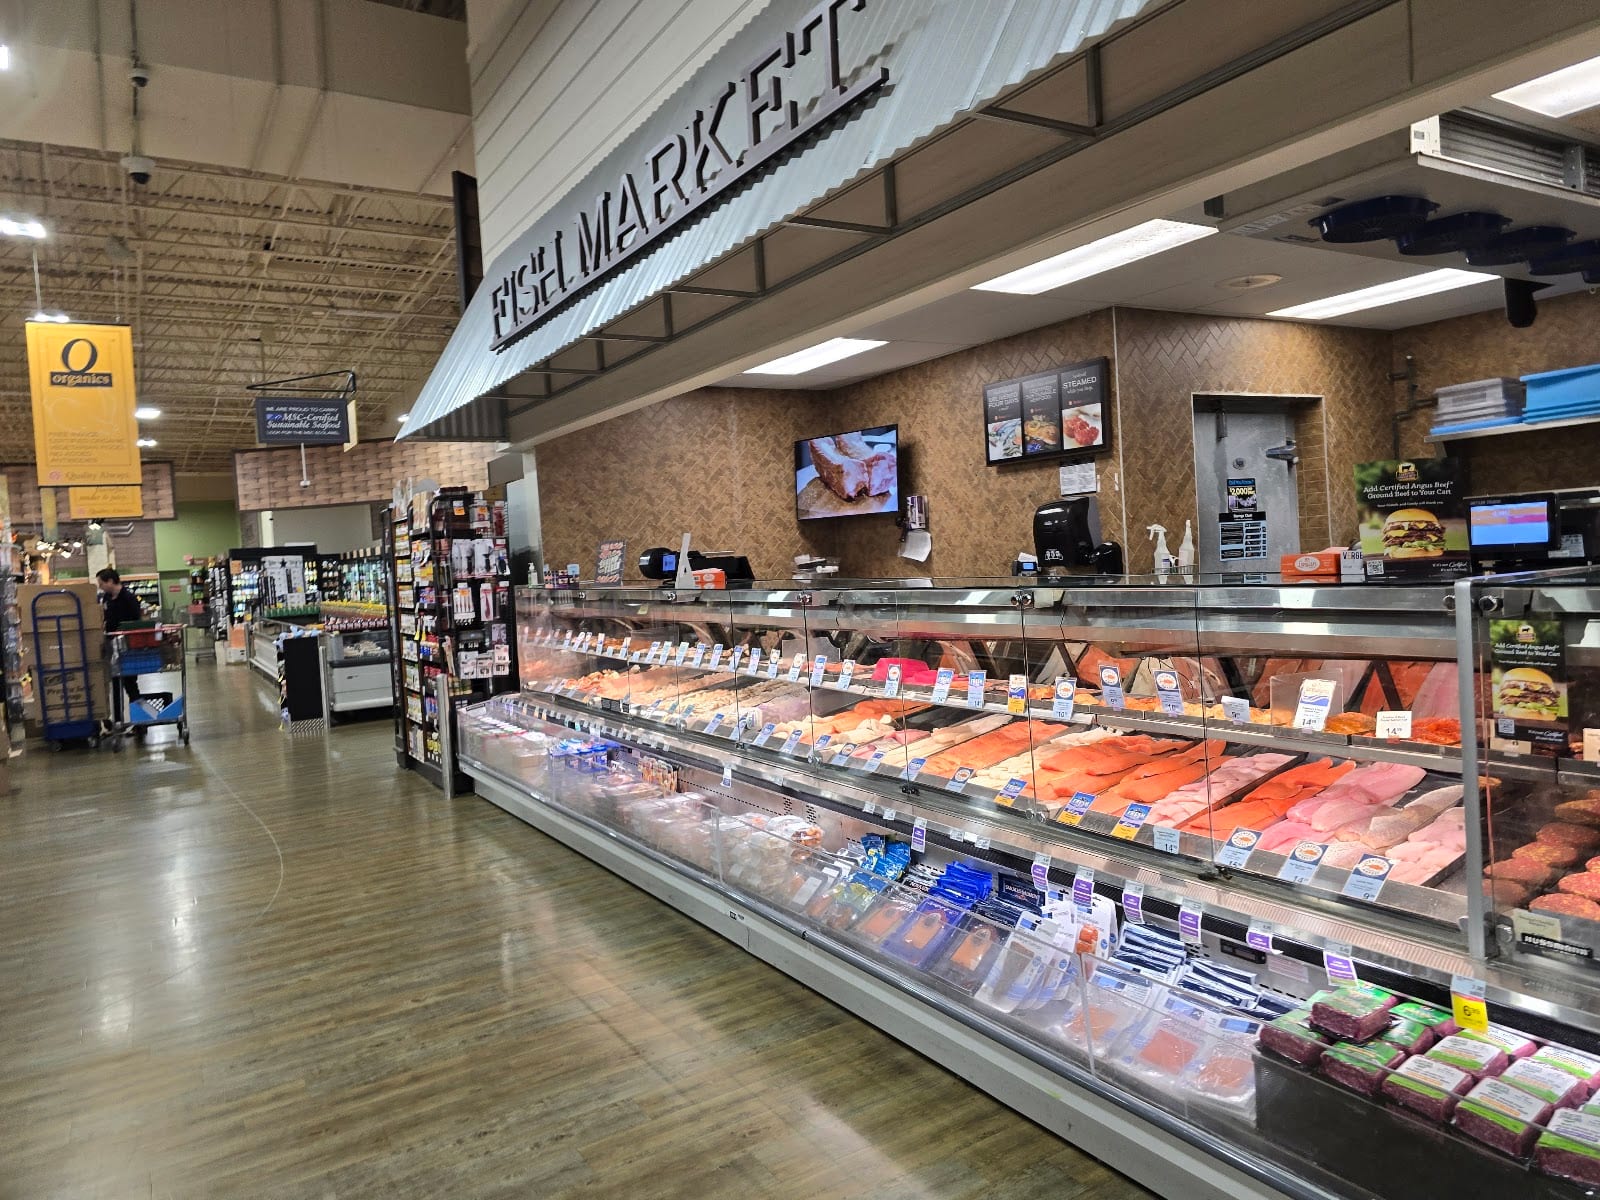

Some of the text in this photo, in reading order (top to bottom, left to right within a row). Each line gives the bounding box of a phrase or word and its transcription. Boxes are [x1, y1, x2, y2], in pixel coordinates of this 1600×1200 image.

[489, 0, 867, 341] FISH MARKET
[52, 374, 110, 387] organics
[1063, 376, 1097, 389] STEAMED
[266, 420, 342, 431] Sustainable Seafood
[1363, 485, 1378, 493] Add
[1379, 482, 1410, 492] Certified
[1410, 482, 1433, 490] Angus
[1367, 491, 1394, 500] Ground
[1394, 490, 1410, 498] Beef
